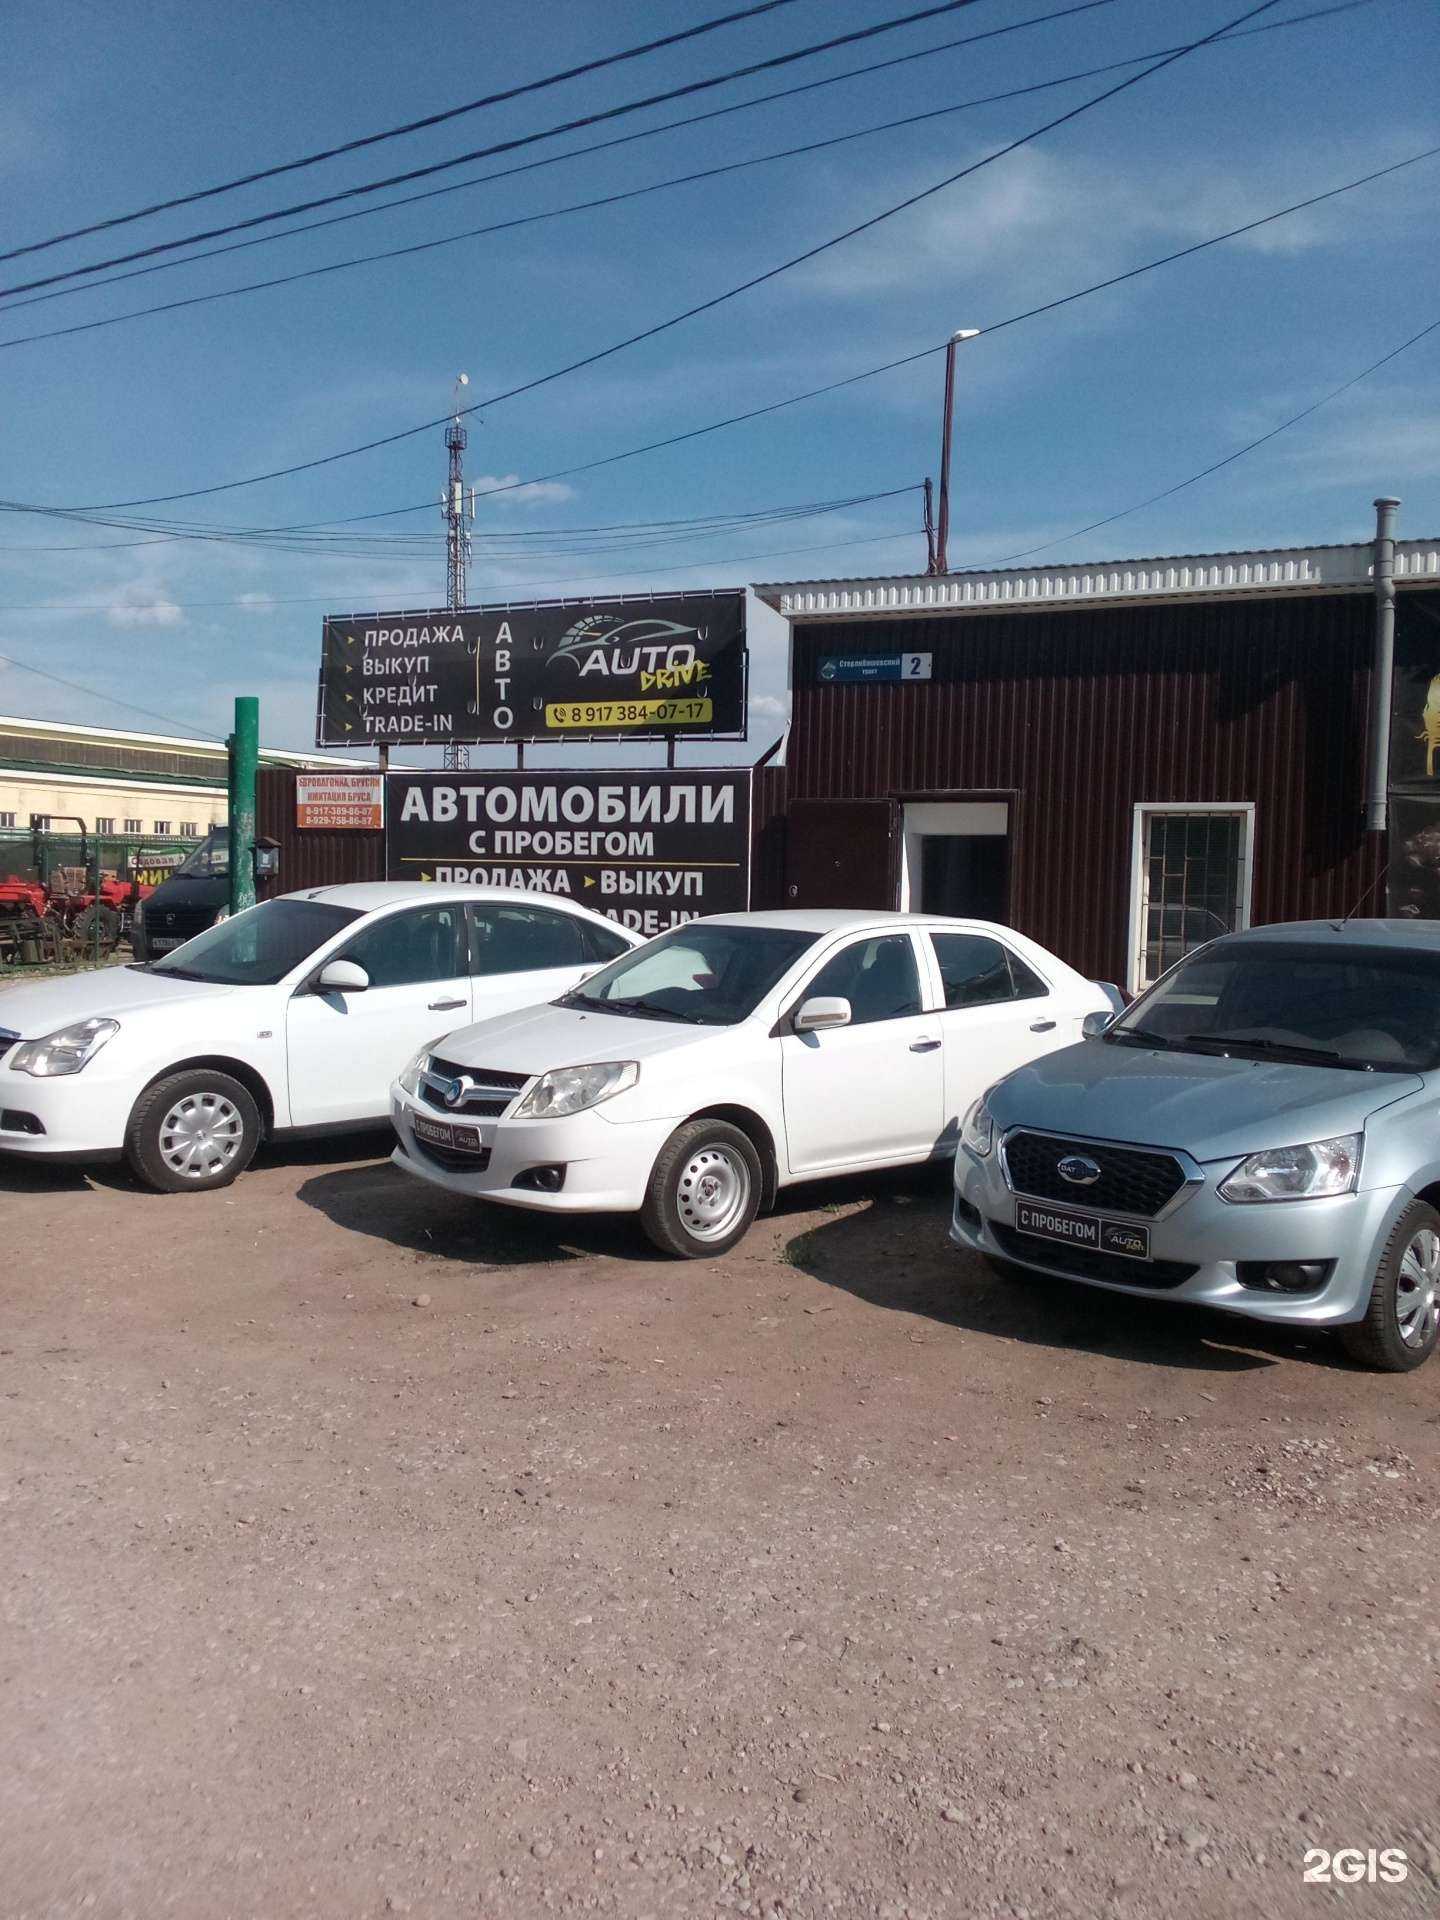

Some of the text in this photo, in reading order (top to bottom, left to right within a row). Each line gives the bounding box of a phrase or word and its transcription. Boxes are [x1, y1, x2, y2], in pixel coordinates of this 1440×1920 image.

[364, 625, 464, 648] ПРОДАЖА
[362, 656, 429, 675] ВЫКУП
[578, 644, 696, 677] AUTO
[910, 657, 921, 675] 2
[493, 621, 514, 730] АВТО
[640, 659, 712, 691] DRIVE
[363, 685, 438, 706] КРЕДИТ
[364, 714, 453, 733] TRADE-IN
[571, 703, 704, 722] 8 917 384-07-17
[400, 785, 735, 824] АВТОМОБИЛИ
[469, 830, 654, 857] С ПРОБЕГОМ
[435, 867, 571, 893] ПРОДАЖА
[600, 871, 703, 896] ВЫКУП
[1021, 1210, 1095, 1240] С ПРОБЕГОМ
[1110, 1235, 1142, 1248] AUTO
